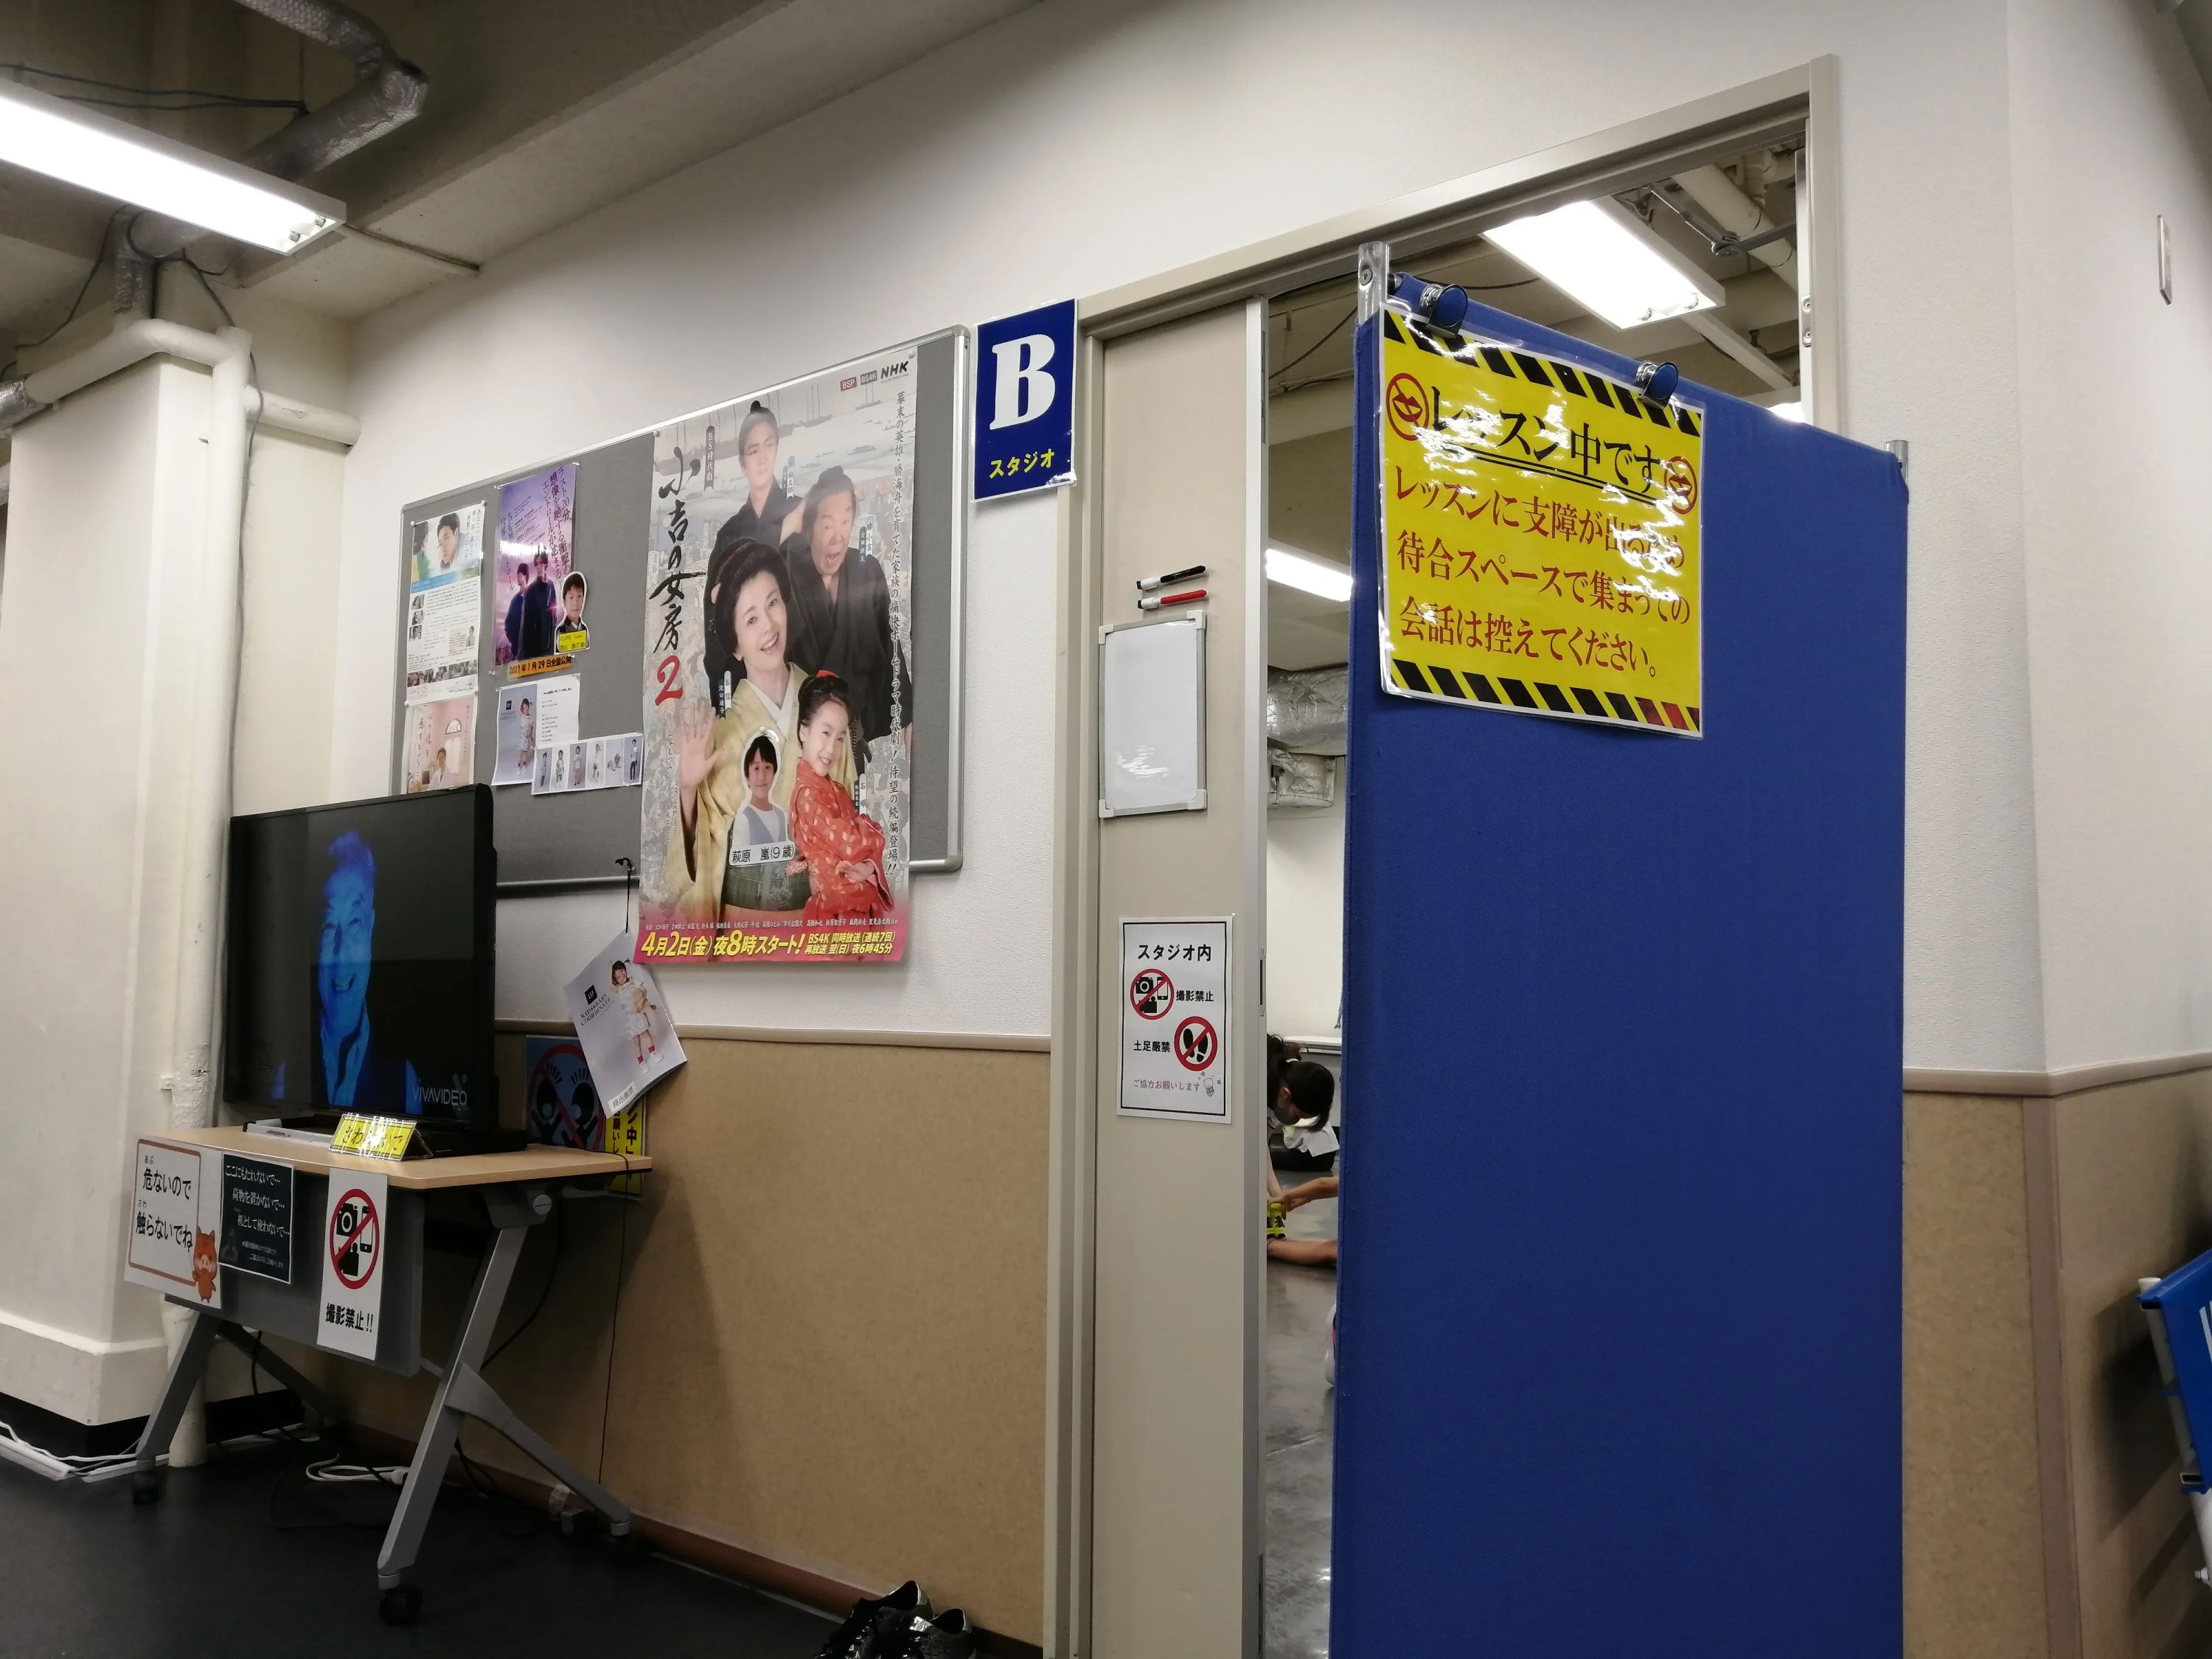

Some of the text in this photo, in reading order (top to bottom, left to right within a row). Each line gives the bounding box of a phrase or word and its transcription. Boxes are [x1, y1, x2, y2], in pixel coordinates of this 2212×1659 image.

[842, 379, 855, 389] BSP
[861, 372, 877, 383] BS4K
[880, 361, 909, 380] NHK
[989, 334, 1056, 431] B
[989, 448, 1055, 480] スタジオ
[1397, 529, 1691, 625] 待合スペースで集まっての
[1400, 596, 1658, 679] 会話は控えてください。
[731, 849, 751, 863] 萩原
[808, 933, 831, 945] BS4K
[1137, 944, 1211, 961] スタジオ内
[1175, 990, 1214, 1003] 撮影禁止
[1133, 1040, 1171, 1053] 土足厳禁
[1133, 1078, 1200, 1093] ご協力お願いします
[413, 1086, 468, 1107] VIVAVIDEO
[142, 1166, 192, 1200] 危ないので
[136, 1209, 193, 1253] 触らないでね
[325, 1302, 374, 1333] 撮影禁止!!
